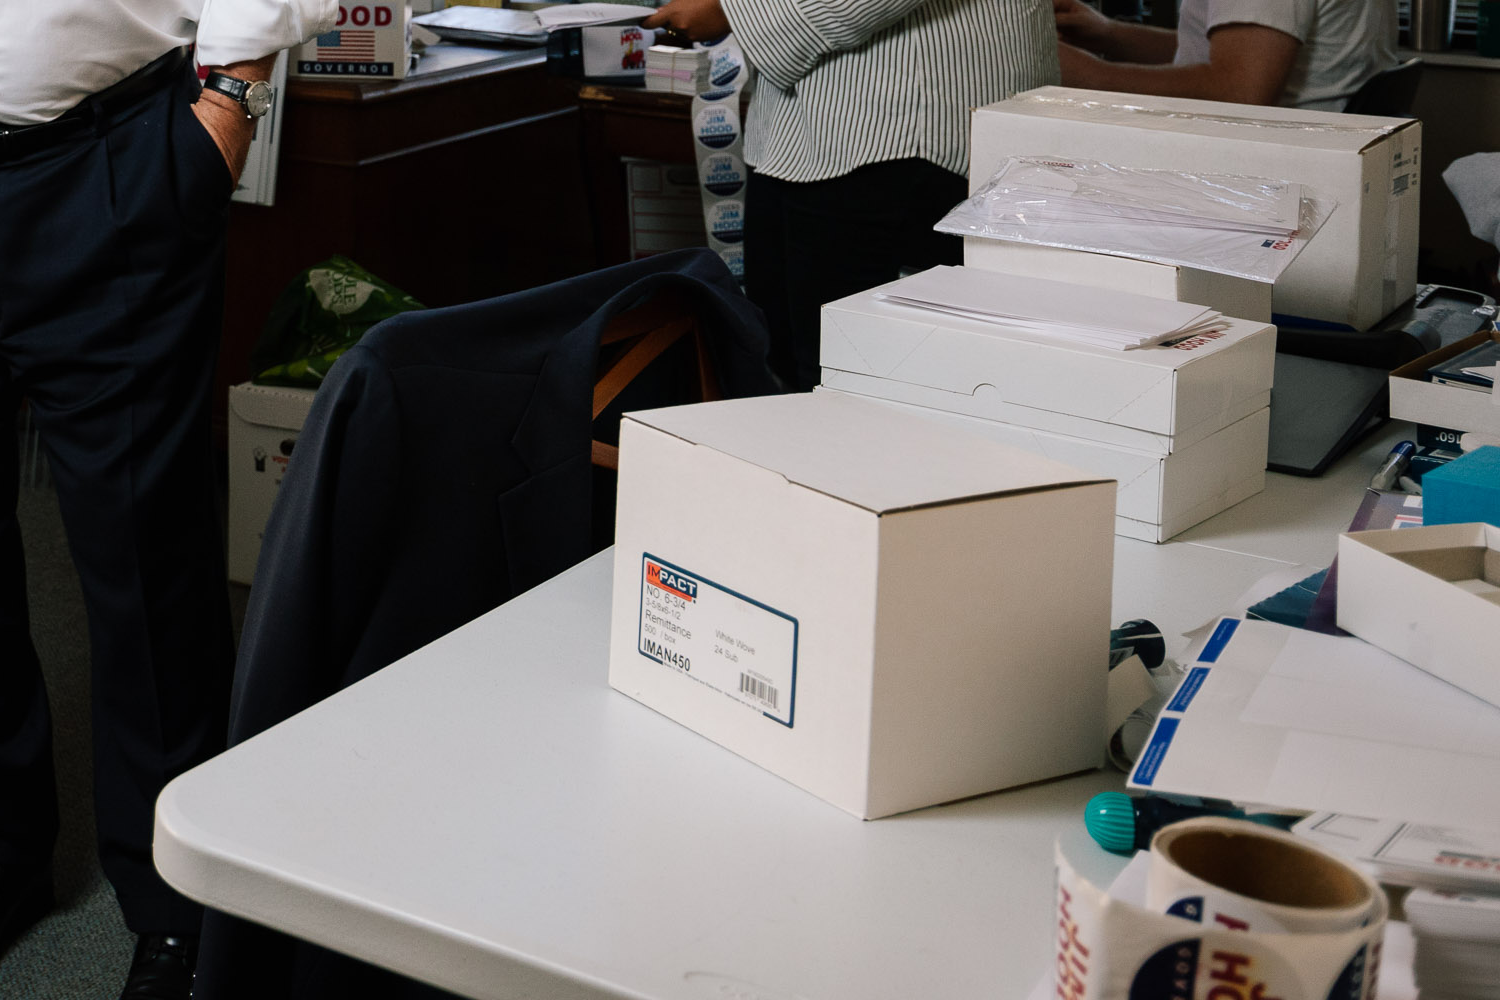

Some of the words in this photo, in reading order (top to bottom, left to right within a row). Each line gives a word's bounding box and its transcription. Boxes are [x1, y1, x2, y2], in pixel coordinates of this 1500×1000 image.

[303, 63, 389, 73] GOVERNOR
[647, 564, 697, 595] IMPACT
[664, 593, 686, 611] 6-3/4
[644, 622, 657, 636] 500
[664, 631, 676, 644] box
[645, 609, 692, 640] Remittance
[714, 628, 735, 647] White
[643, 637, 691, 672] IMAN450
